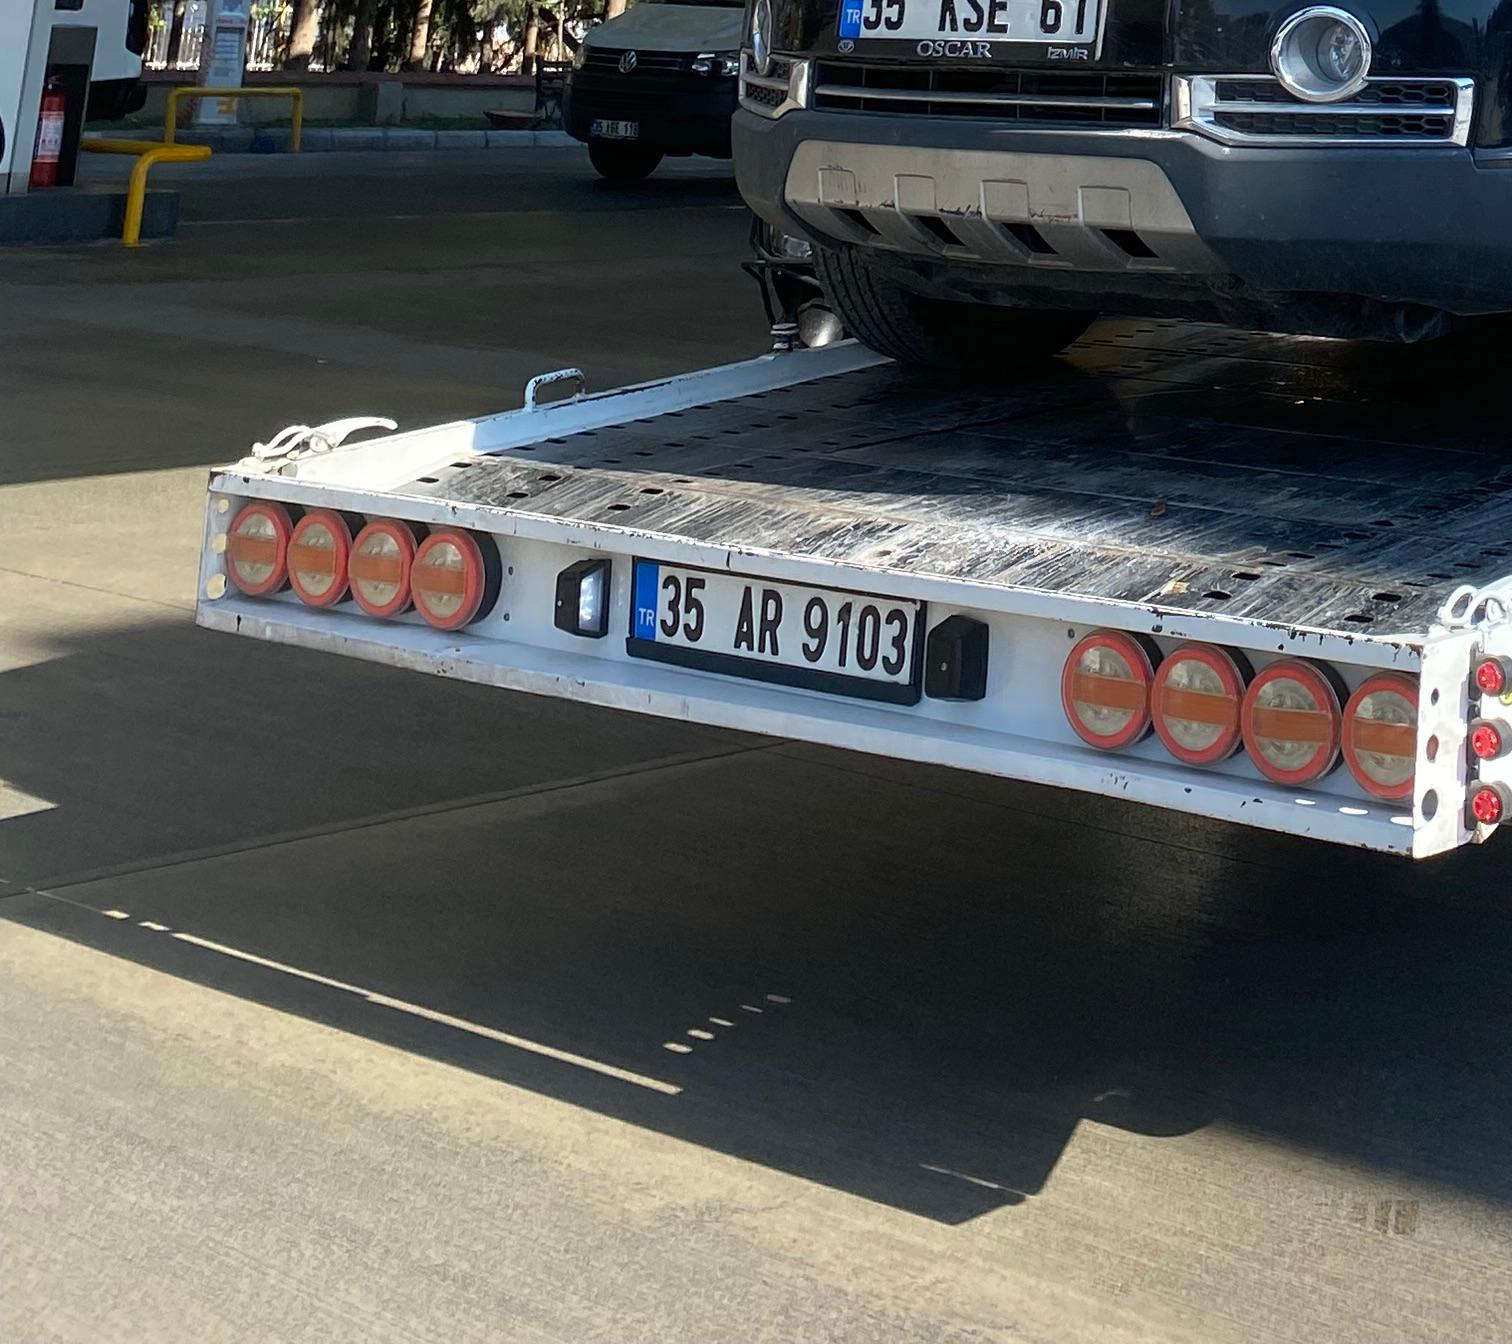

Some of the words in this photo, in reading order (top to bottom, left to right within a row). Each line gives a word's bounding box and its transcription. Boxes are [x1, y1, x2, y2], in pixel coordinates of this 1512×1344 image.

[846, 8, 861, 24] TR
[916, 39, 993, 58] OSCAR
[638, 608, 656, 627] TR
[659, 574, 706, 643] 35
[733, 585, 784, 657] AR
[801, 596, 909, 676] 9103
